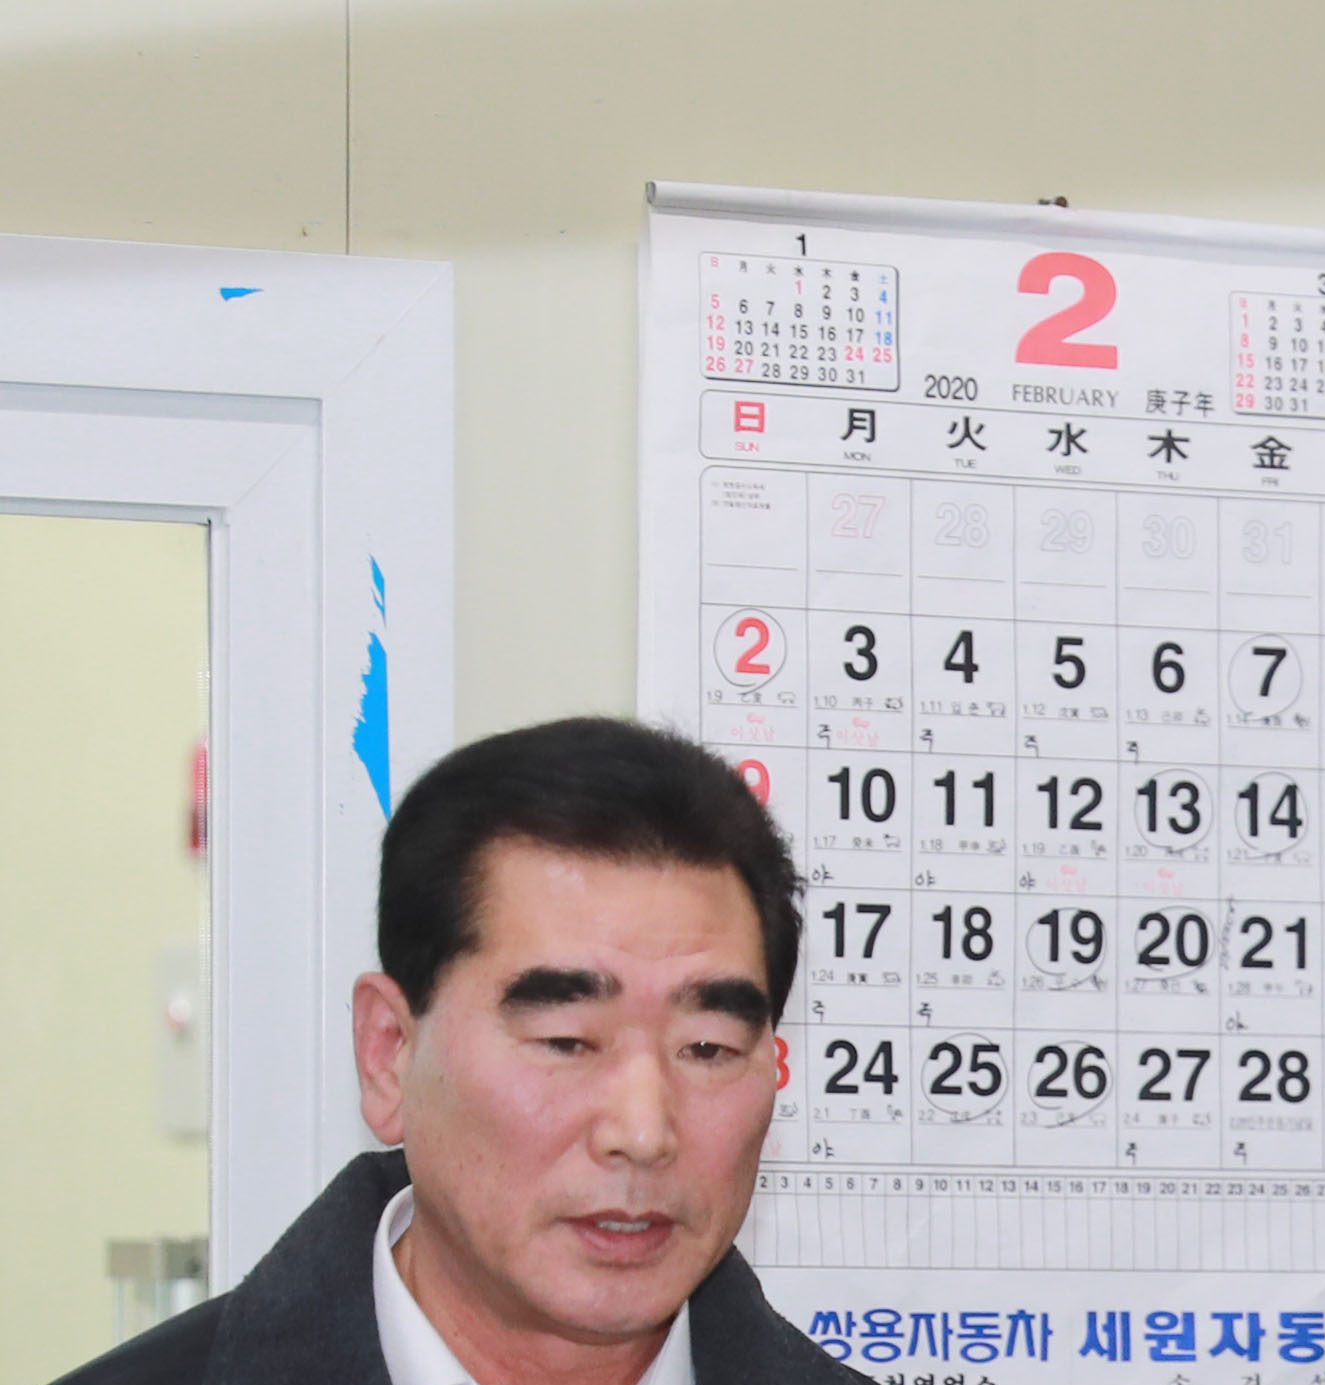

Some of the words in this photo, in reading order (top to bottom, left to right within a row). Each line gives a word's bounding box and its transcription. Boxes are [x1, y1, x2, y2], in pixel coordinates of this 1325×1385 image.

[796, 234, 807, 256] 1
[795, 280, 803, 294] 1
[822, 285, 831, 299] 2
[850, 287, 859, 302] 3
[880, 291, 887, 303] 4
[711, 294, 720, 309] 5
[739, 299, 748, 314] 6
[766, 301, 775, 315] 7
[794, 304, 803, 318] 8
[822, 306, 831, 320] 9
[848, 308, 864, 323] 10
[876, 311, 892, 325] 11
[1015, 251, 1118, 370] 2
[1243, 314, 1249, 328] 1
[1269, 316, 1277, 331] 2
[1294, 318, 1302, 332] 3
[707, 316, 725, 330] 12
[736, 321, 753, 335] 13
[763, 323, 779, 336] 14
[791, 325, 808, 339] 15
[820, 327, 836, 341] 16
[847, 329, 864, 343] 17
[876, 332, 892, 346] 18
[1241, 334, 1250, 348] 8
[1269, 337, 1277, 350] 9
[1292, 338, 1308, 352] 10
[707, 336, 726, 351] 19
[734, 341, 753, 356] 20
[761, 343, 779, 357] 21
[790, 345, 808, 360] 22
[818, 347, 836, 361] 23
[845, 347, 864, 361] 24
[873, 349, 892, 363] 25
[1238, 354, 1255, 368] 15
[1266, 357, 1282, 371] 16
[1292, 358, 1307, 372] 17
[706, 357, 726, 372] 26
[735, 359, 754, 374] 27
[762, 363, 781, 378] 28
[790, 365, 809, 380] 29
[818, 367, 837, 382] 30
[846, 369, 864, 384] 31
[1236, 373, 1255, 388] 22
[1265, 376, 1282, 391] 23
[1290, 378, 1308, 392] 24
[924, 375, 978, 400] 2020
[1012, 384, 1119, 408] FEBRUARY
[1145, 388, 1215, 418] 庚子年
[1236, 394, 1255, 408] 29
[1265, 397, 1283, 411] 30
[1290, 398, 1308, 412] 31
[734, 401, 765, 434] 日
[840, 408, 876, 444] 月
[946, 416, 987, 450] 火
[1047, 422, 1088, 456] 水
[1147, 429, 1190, 464] 木
[1251, 435, 1292, 470] 金
[735, 441, 760, 452] SUN
[844, 451, 871, 462] MON
[954, 458, 976, 469] TUE
[1054, 464, 1082, 476] WED
[1157, 470, 1180, 481] THU
[830, 493, 887, 538] 27
[935, 502, 990, 549] 28
[1040, 508, 1095, 556] 29
[735, 617, 771, 675] 2
[843, 625, 878, 681] 3
[943, 630, 979, 684] 4
[1052, 636, 1086, 689] 5
[1152, 642, 1185, 694] 6
[1252, 648, 1287, 697] 7
[828, 766, 896, 823] 10
[933, 770, 994, 827] 11
[1037, 776, 1103, 831] 12
[1137, 779, 1201, 834] 13
[1238, 781, 1302, 838] 14
[822, 902, 892, 958] 17
[932, 905, 993, 961] 18
[1037, 909, 1103, 964] 19
[1138, 912, 1209, 967] 20
[1241, 916, 1306, 970] 21
[825, 1040, 899, 1095] 24
[929, 1042, 1002, 1096] 25
[1035, 1045, 1107, 1099] 26
[1138, 1048, 1211, 1101] 27
[1239, 1049, 1311, 1103] 28
[760, 1176, 768, 1189] 2
[780, 1177, 788, 1189] 3
[803, 1177, 812, 1189] 4
[825, 1178, 834, 1190] 5
[846, 1178, 854, 1190] 6
[870, 1178, 878, 1190] 7
[893, 1179, 901, 1191] 8
[915, 1179, 923, 1191] 9
[934, 1179, 948, 1192] 10
[957, 1180, 971, 1192] 11
[980, 1180, 994, 1192] 12
[1002, 1180, 1016, 1193] 13
[809, 1308, 1054, 1363] 쌍용자동차
